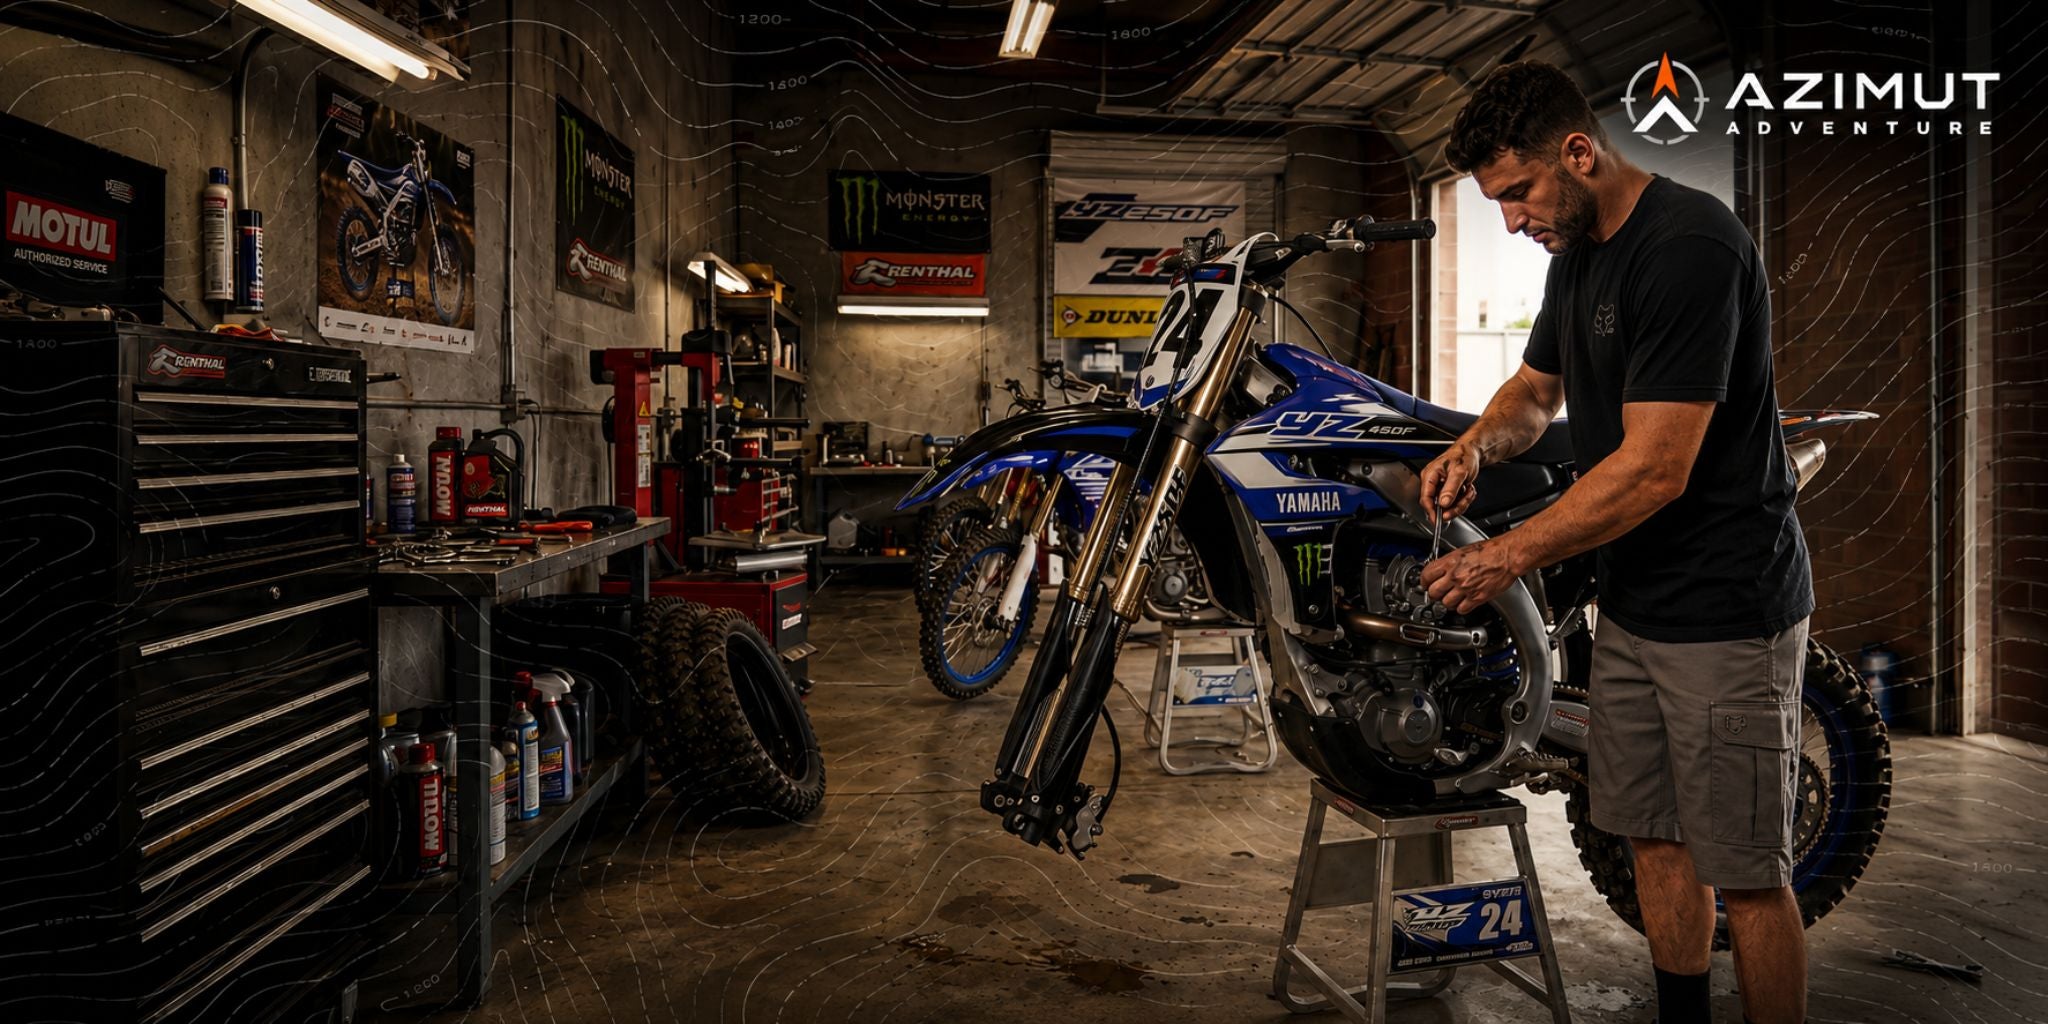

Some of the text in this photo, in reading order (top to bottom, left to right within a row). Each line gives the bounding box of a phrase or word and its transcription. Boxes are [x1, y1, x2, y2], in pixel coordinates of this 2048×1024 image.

[586, 149, 632, 199] MONSTER
[886, 189, 985, 212] MONSTER
[11, 200, 112, 254] MOTUL
[14, 248, 108, 274] AUTHORIZED SERVICE
[1084, 310, 1158, 324] DUNL
[1276, 491, 1341, 514] YAMAHA
[1478, 899, 1523, 941] 24
